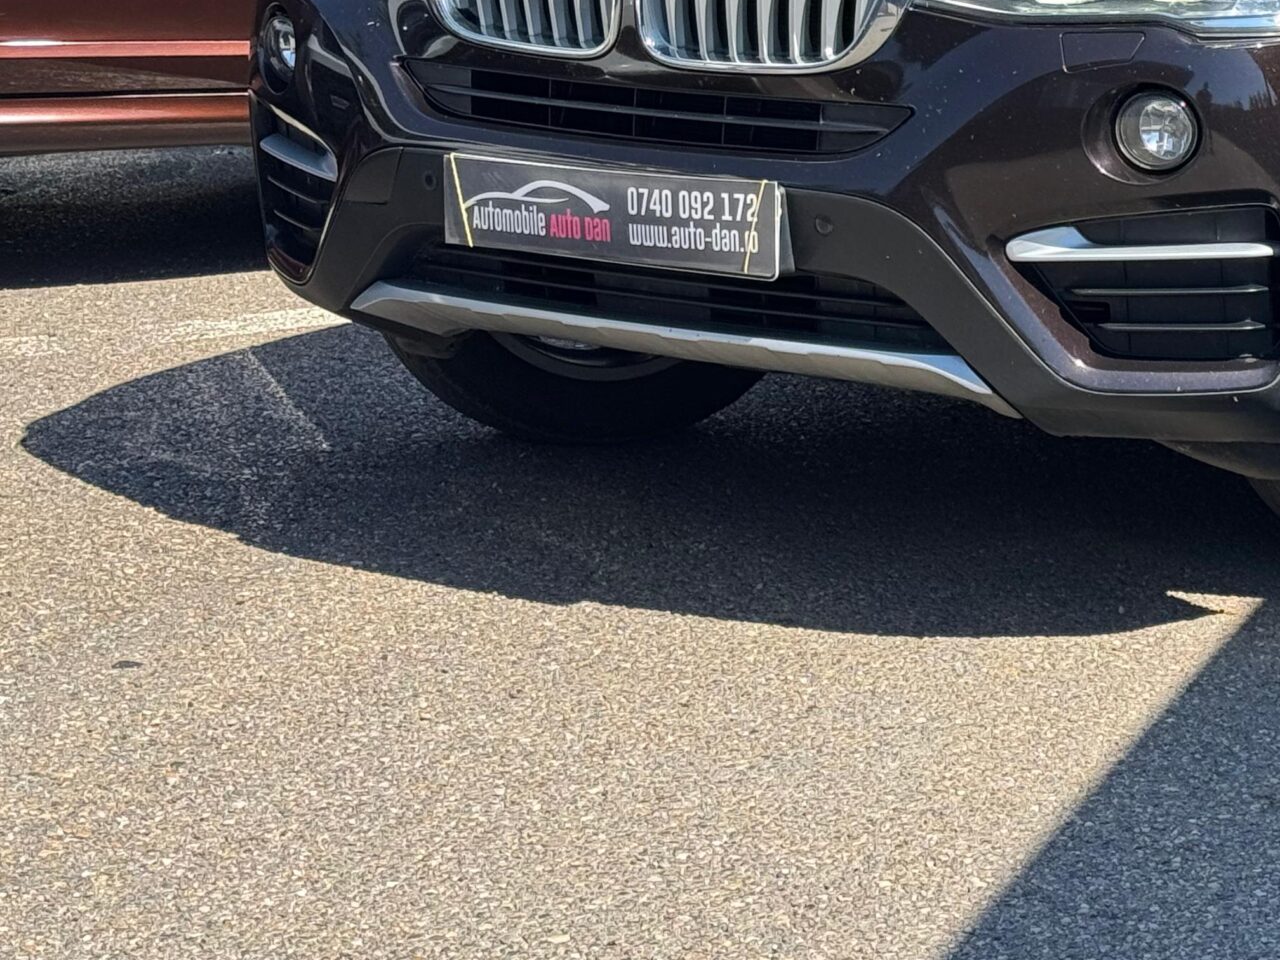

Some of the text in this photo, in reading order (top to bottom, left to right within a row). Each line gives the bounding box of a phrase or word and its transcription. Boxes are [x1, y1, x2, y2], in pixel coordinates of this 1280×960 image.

[627, 187, 759, 222] 0740 092 172
[628, 222, 759, 254] www.auto-dan.ro
